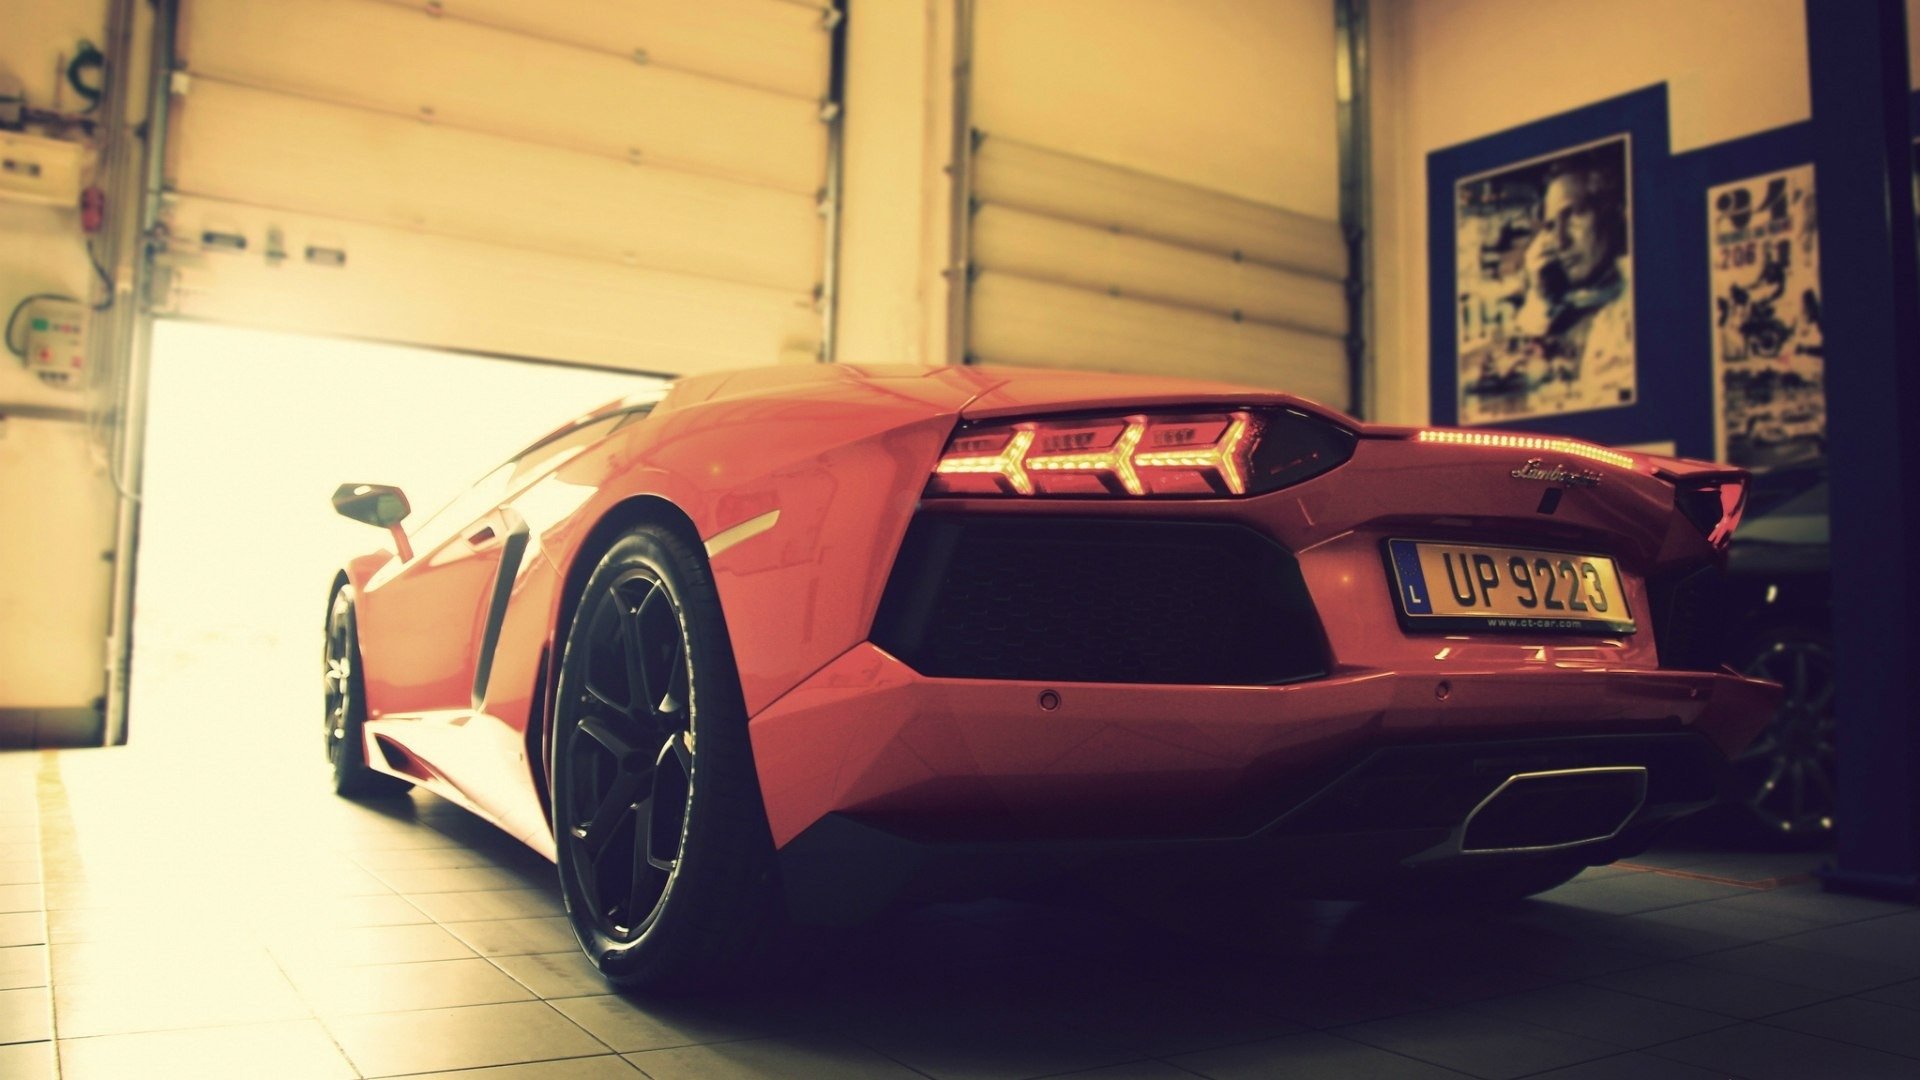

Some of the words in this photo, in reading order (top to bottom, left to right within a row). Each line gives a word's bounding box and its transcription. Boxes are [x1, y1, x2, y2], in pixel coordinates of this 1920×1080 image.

[1443, 552, 1500, 608] UP
[1508, 556, 1608, 612] 9223
[1408, 584, 1421, 604] L
[1487, 618, 1582, 629] www.ct-car.com
